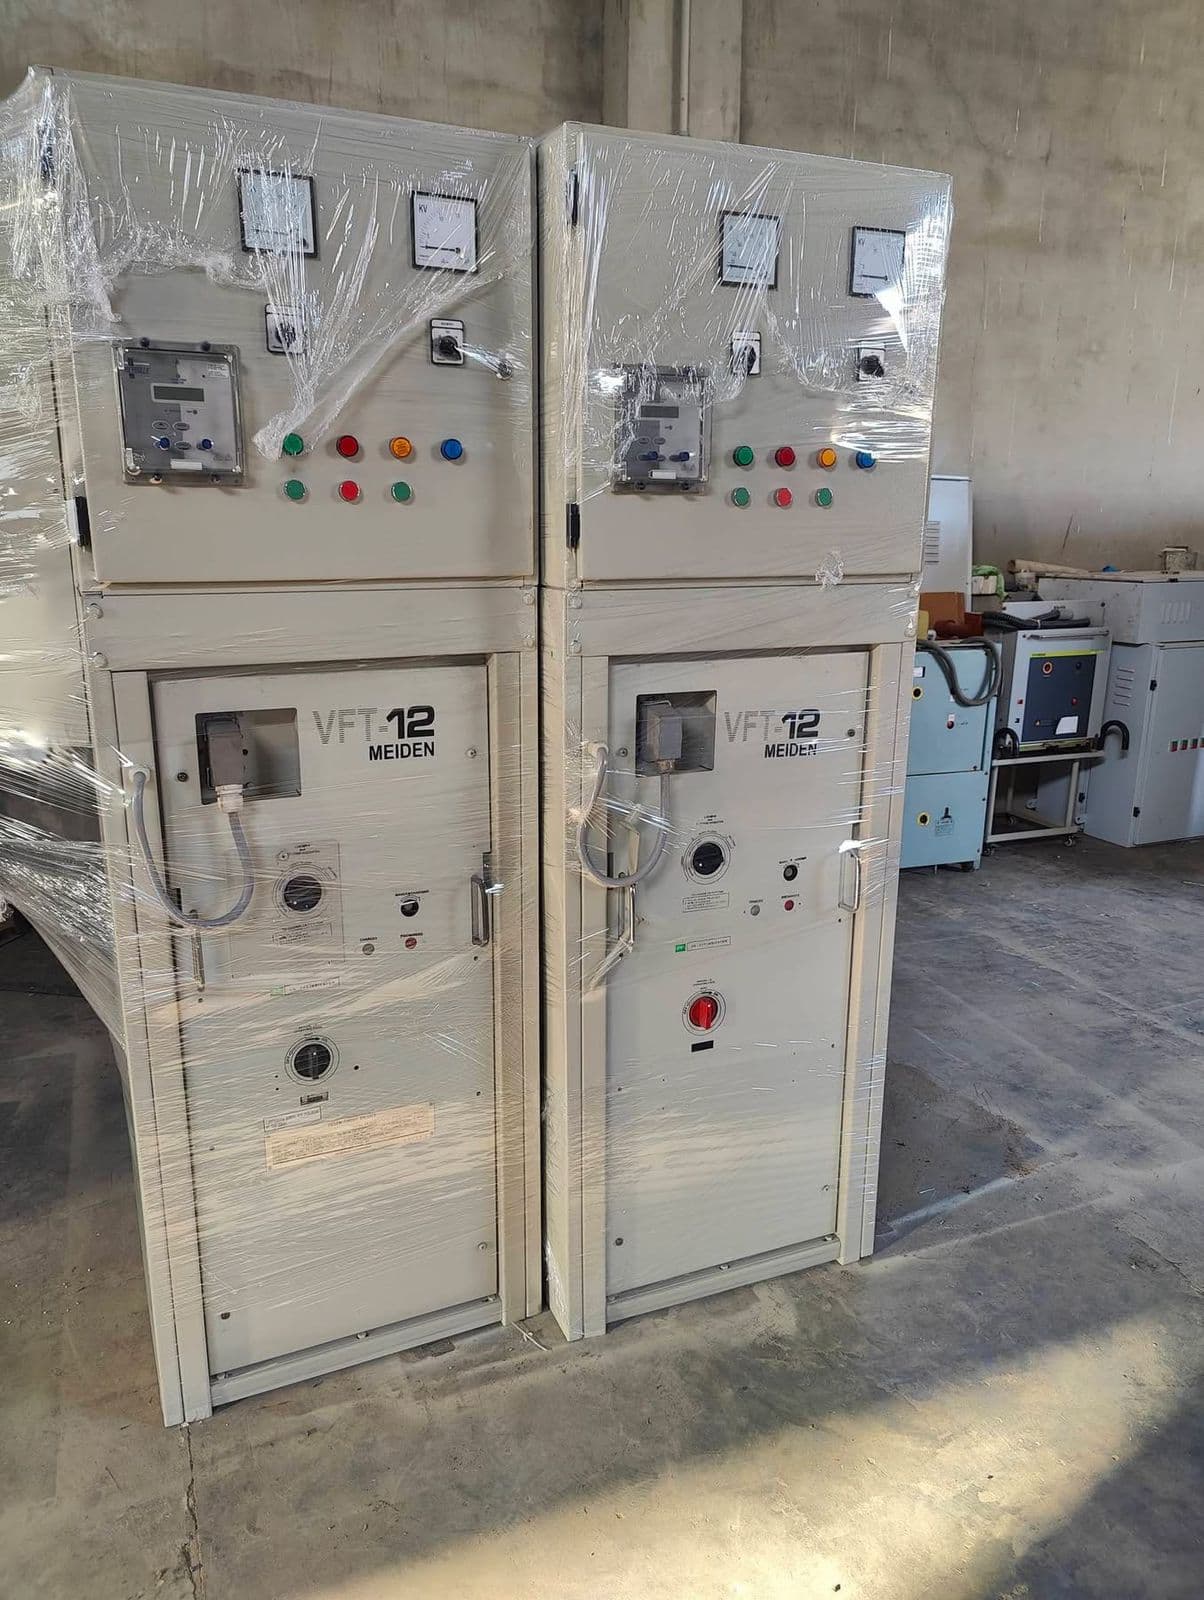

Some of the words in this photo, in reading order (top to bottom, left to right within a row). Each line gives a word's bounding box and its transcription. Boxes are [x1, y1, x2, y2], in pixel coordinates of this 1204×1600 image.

[312, 705, 435, 744] VFT-12
[725, 709, 820, 742] VFT-12
[369, 742, 434, 761] MEIDEN
[765, 743, 817, 759] MEIDEN
